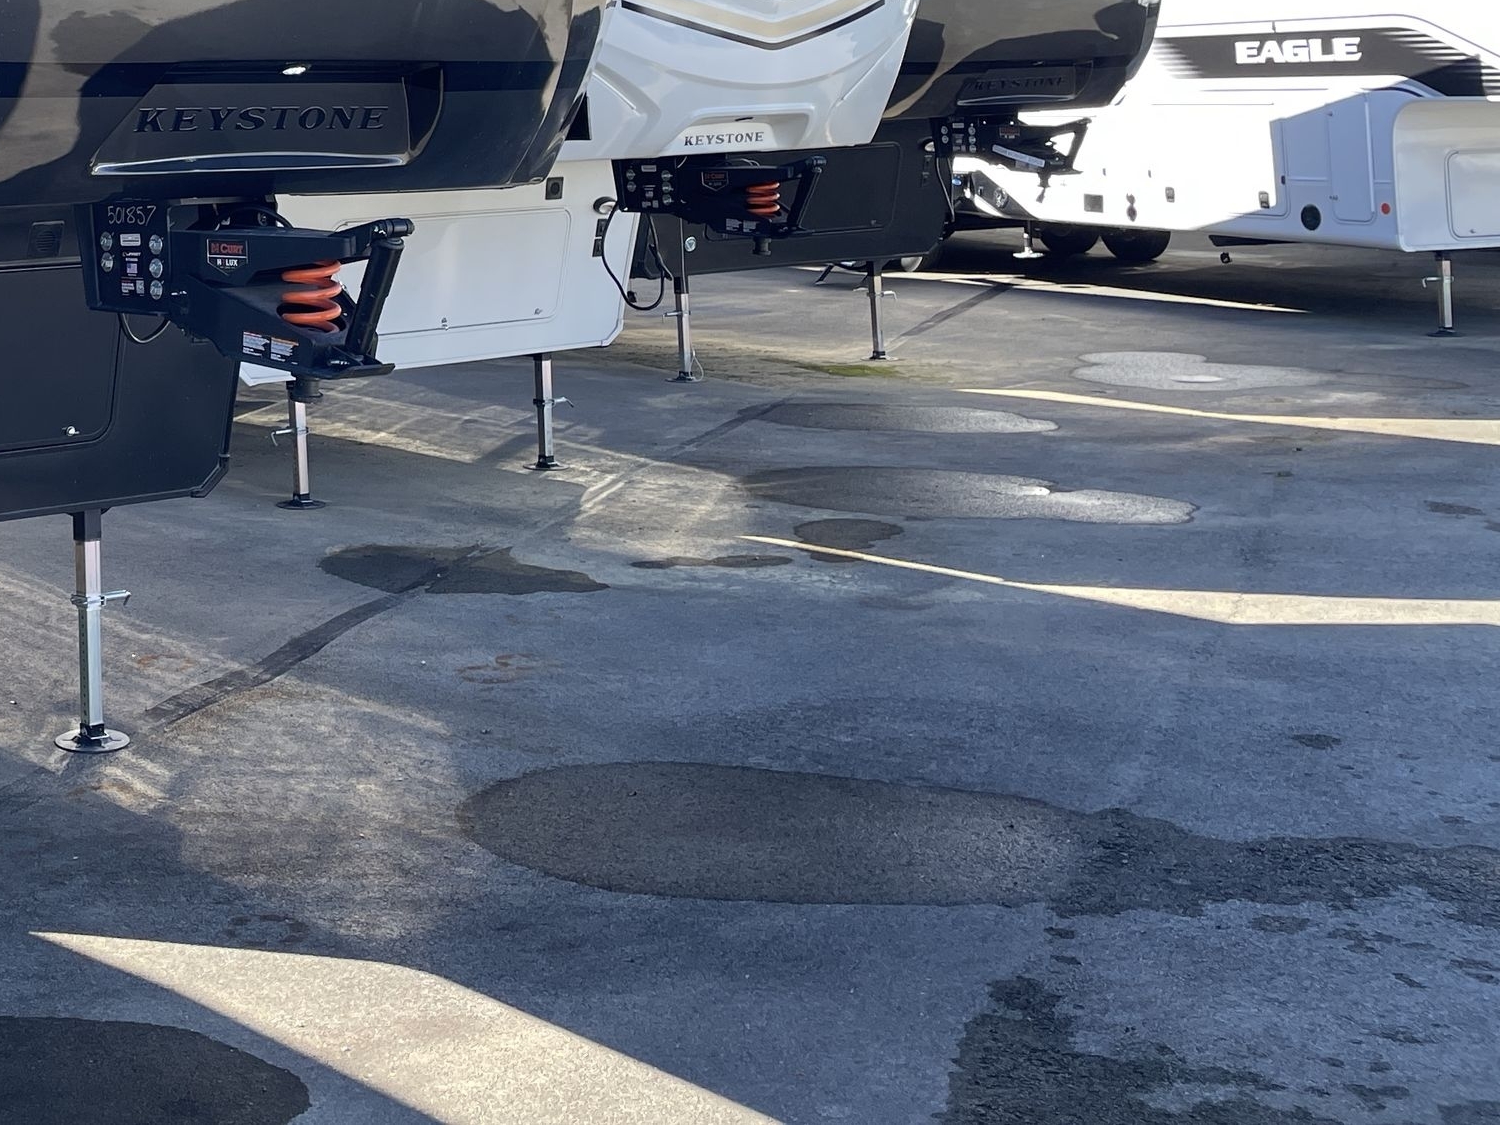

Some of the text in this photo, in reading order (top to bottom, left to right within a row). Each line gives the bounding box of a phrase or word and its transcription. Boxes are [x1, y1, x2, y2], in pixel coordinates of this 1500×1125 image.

[1234, 36, 1363, 65] EAGLE
[133, 105, 389, 133] KEYSTONE
[683, 131, 765, 147] KEYSTONE
[107, 205, 157, 226] 501857
